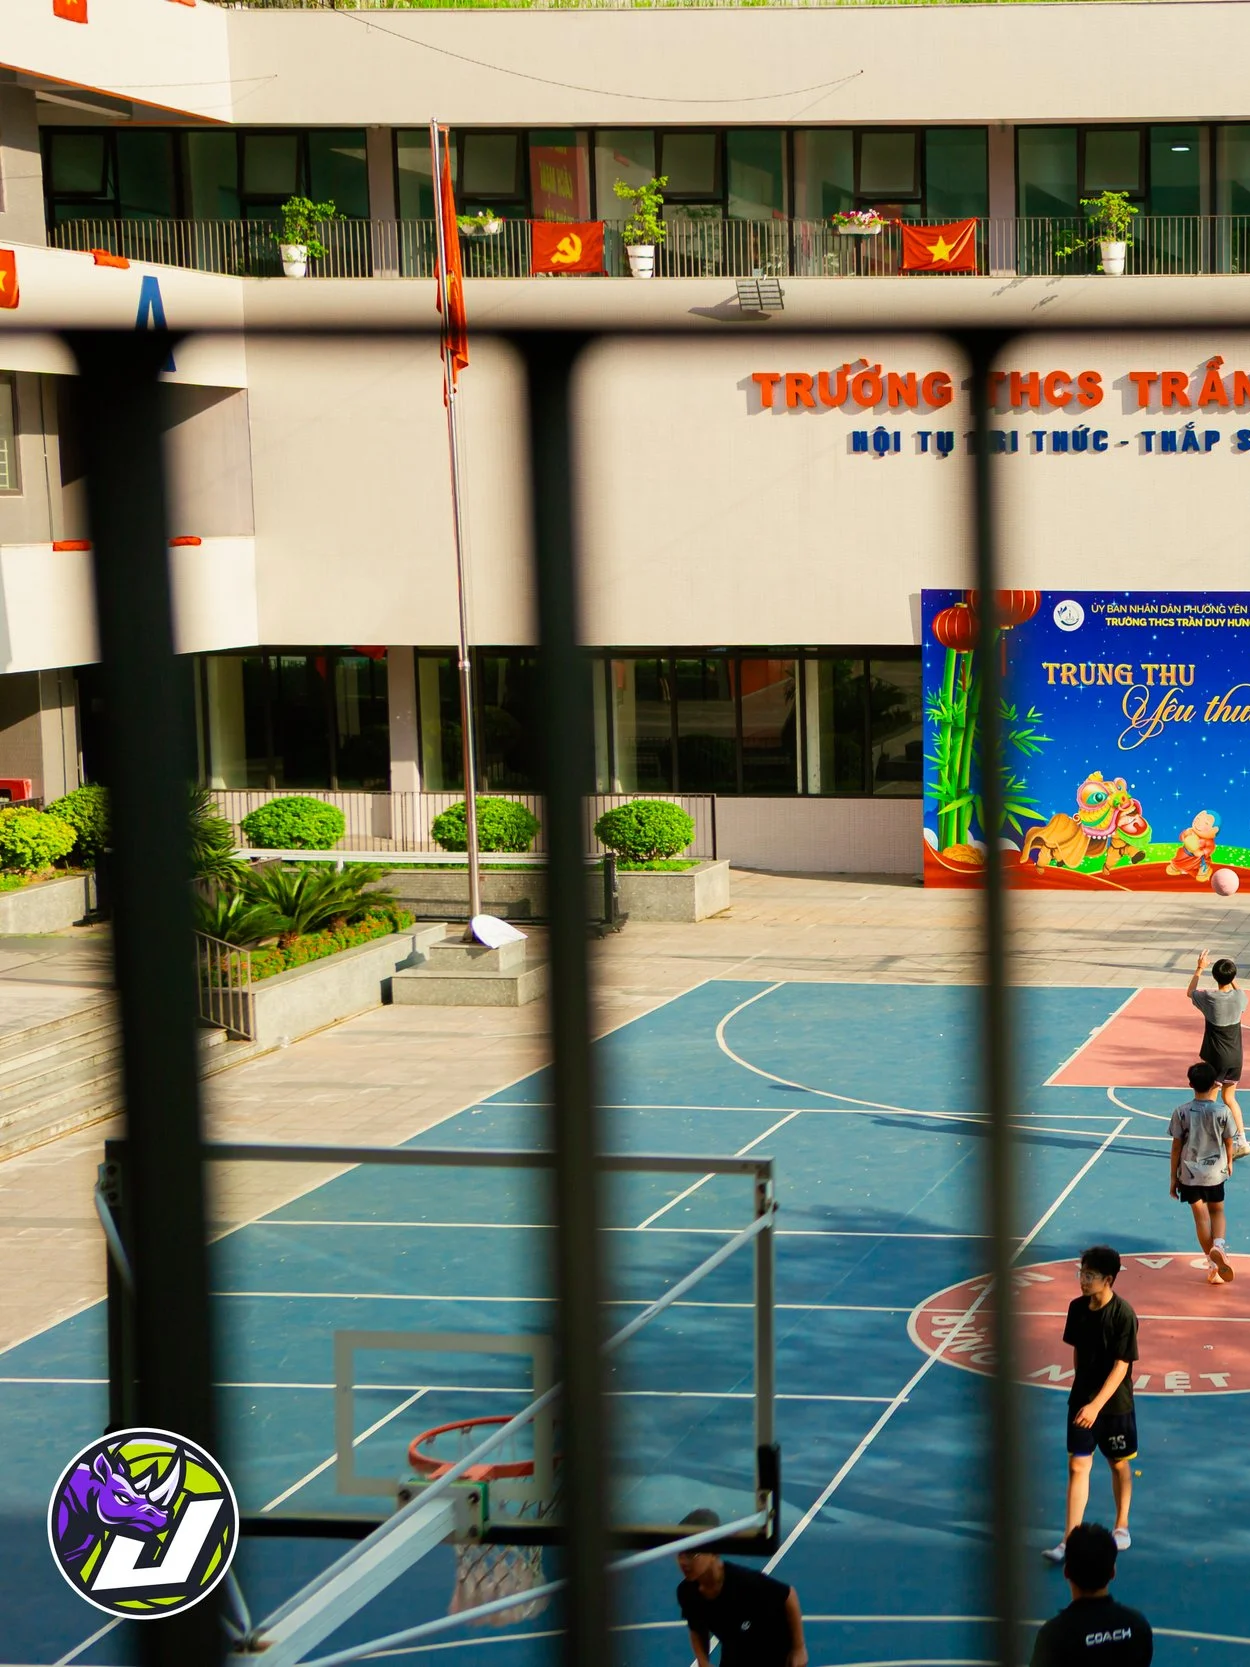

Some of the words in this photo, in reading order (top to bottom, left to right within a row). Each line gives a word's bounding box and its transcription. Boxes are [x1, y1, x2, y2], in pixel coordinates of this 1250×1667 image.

[751, 358, 954, 408] TRƯỜNG
[852, 426, 901, 456] HỘI
[917, 431, 954, 456] TỤ
[970, 430, 1018, 452] RI
[1032, 424, 1108, 452] THỨC
[1141, 421, 1220, 452] THẮP
[1105, 615, 1147, 627] TRƯỜNG
[1148, 618, 1175, 627] THCS
[1176, 615, 1203, 627] TRẦN
[1204, 618, 1226, 627] DUY
[1106, 604, 1127, 613] BAN
[1129, 602, 1159, 613] NHÂN
[1160, 603, 1181, 614] DÂN
[1228, 603, 1248, 614] YÊN
[1042, 662, 1133, 687] TRUNG
[1141, 663, 1196, 687] THU
[1118, 684, 1197, 750] Yêu
[1027, 1364, 1231, 1393] NIỆT
[1085, 1627, 1132, 1647] COACH
